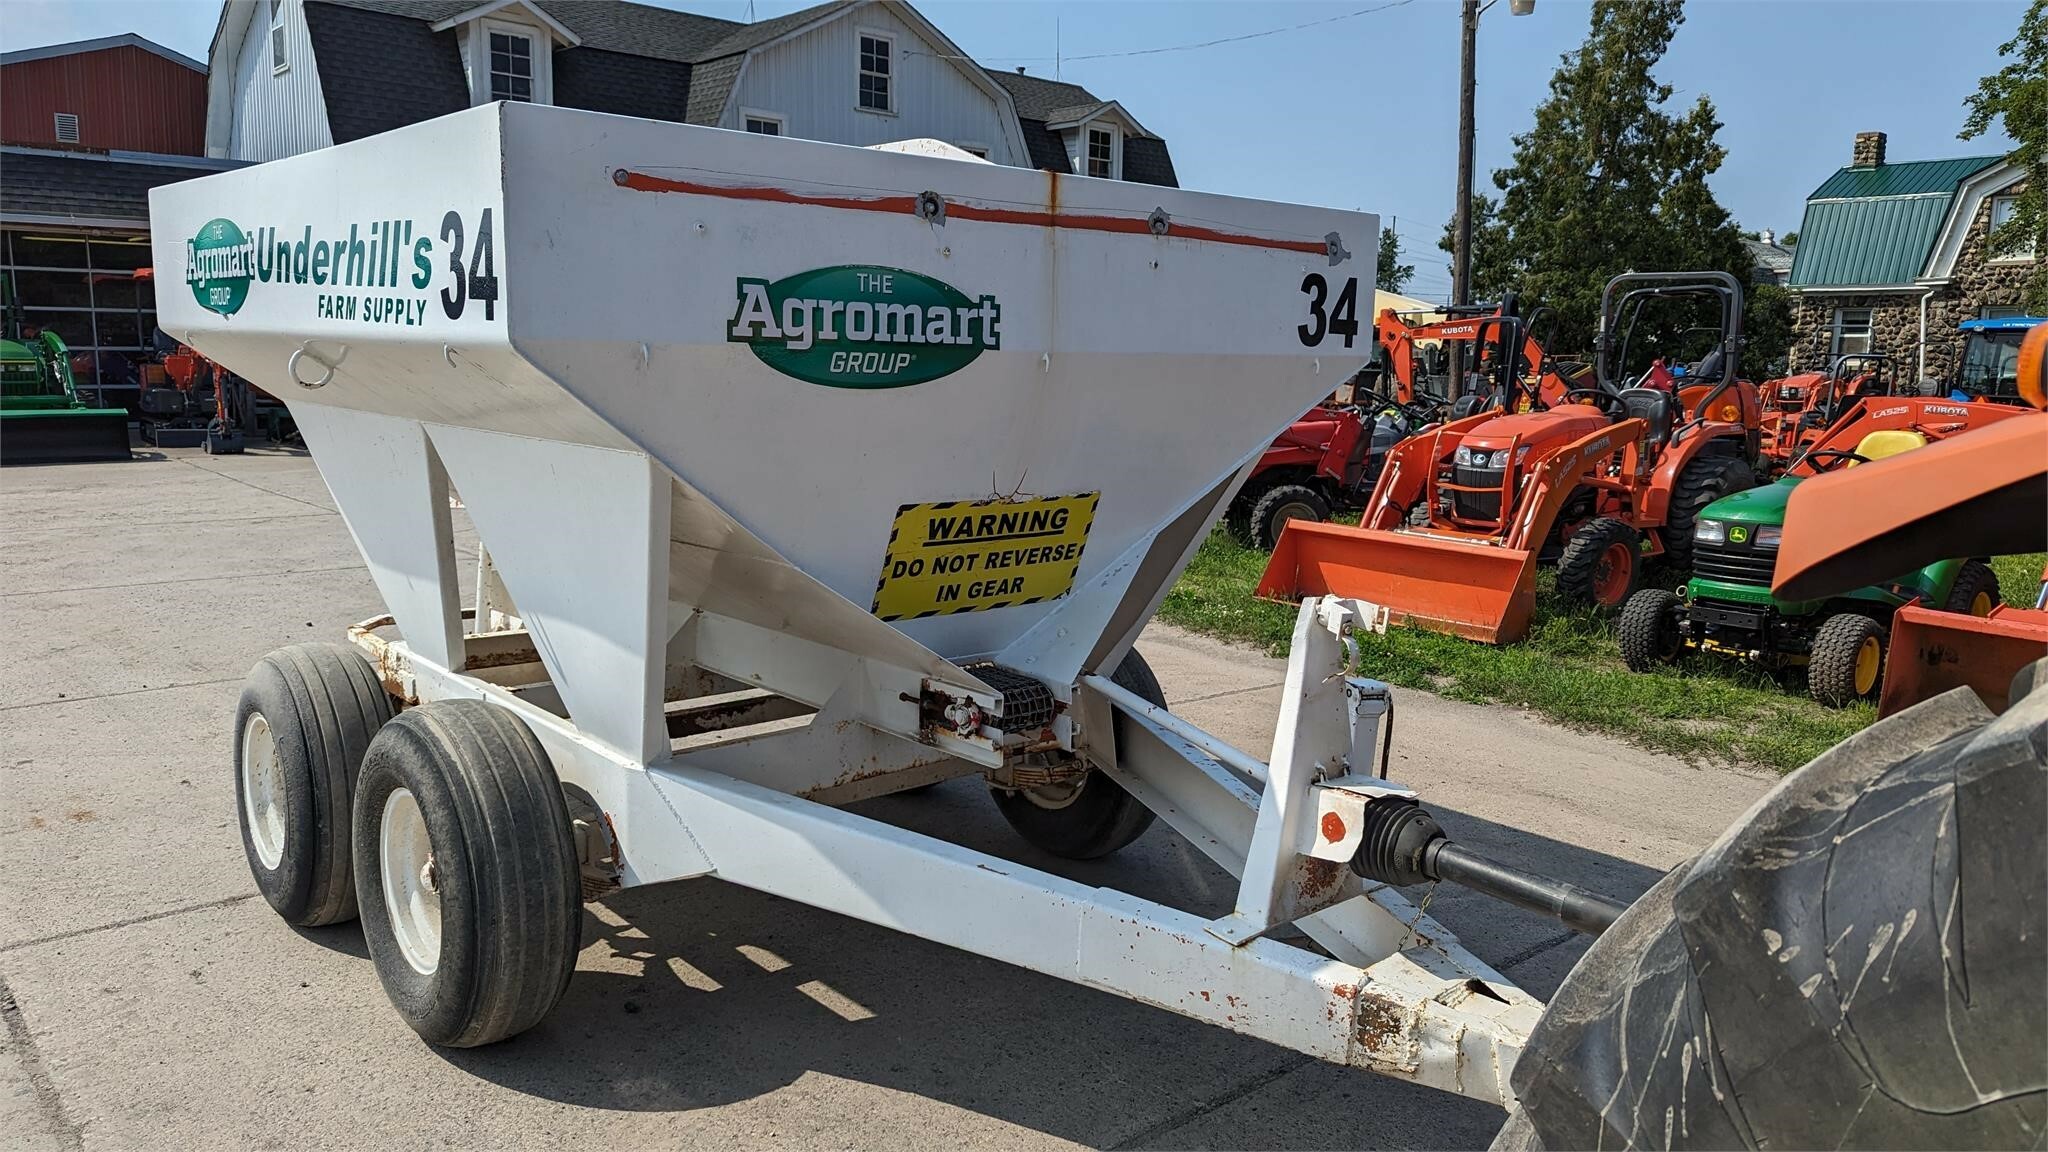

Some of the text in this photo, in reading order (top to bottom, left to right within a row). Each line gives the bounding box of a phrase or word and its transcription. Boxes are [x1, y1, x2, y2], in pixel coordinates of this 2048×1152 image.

[213, 224, 223, 241] THE
[187, 235, 254, 288] Agromart
[257, 219, 433, 290] Underhill's
[439, 207, 499, 321] 34
[209, 287, 231, 306] GROUP
[857, 273, 893, 294] THE
[318, 294, 427, 326] FARM SUPPLY
[731, 283, 998, 350] Agromart
[1297, 272, 1359, 348] 34
[1441, 325, 1475, 335] KUBOTA
[829, 351, 911, 374] GROUP
[1923, 404, 1969, 417] KUBOTA
[928, 507, 1070, 541] WARNING
[891, 543, 1078, 579] DO NOT REVERSE
[936, 576, 1025, 602] IN GEAR
